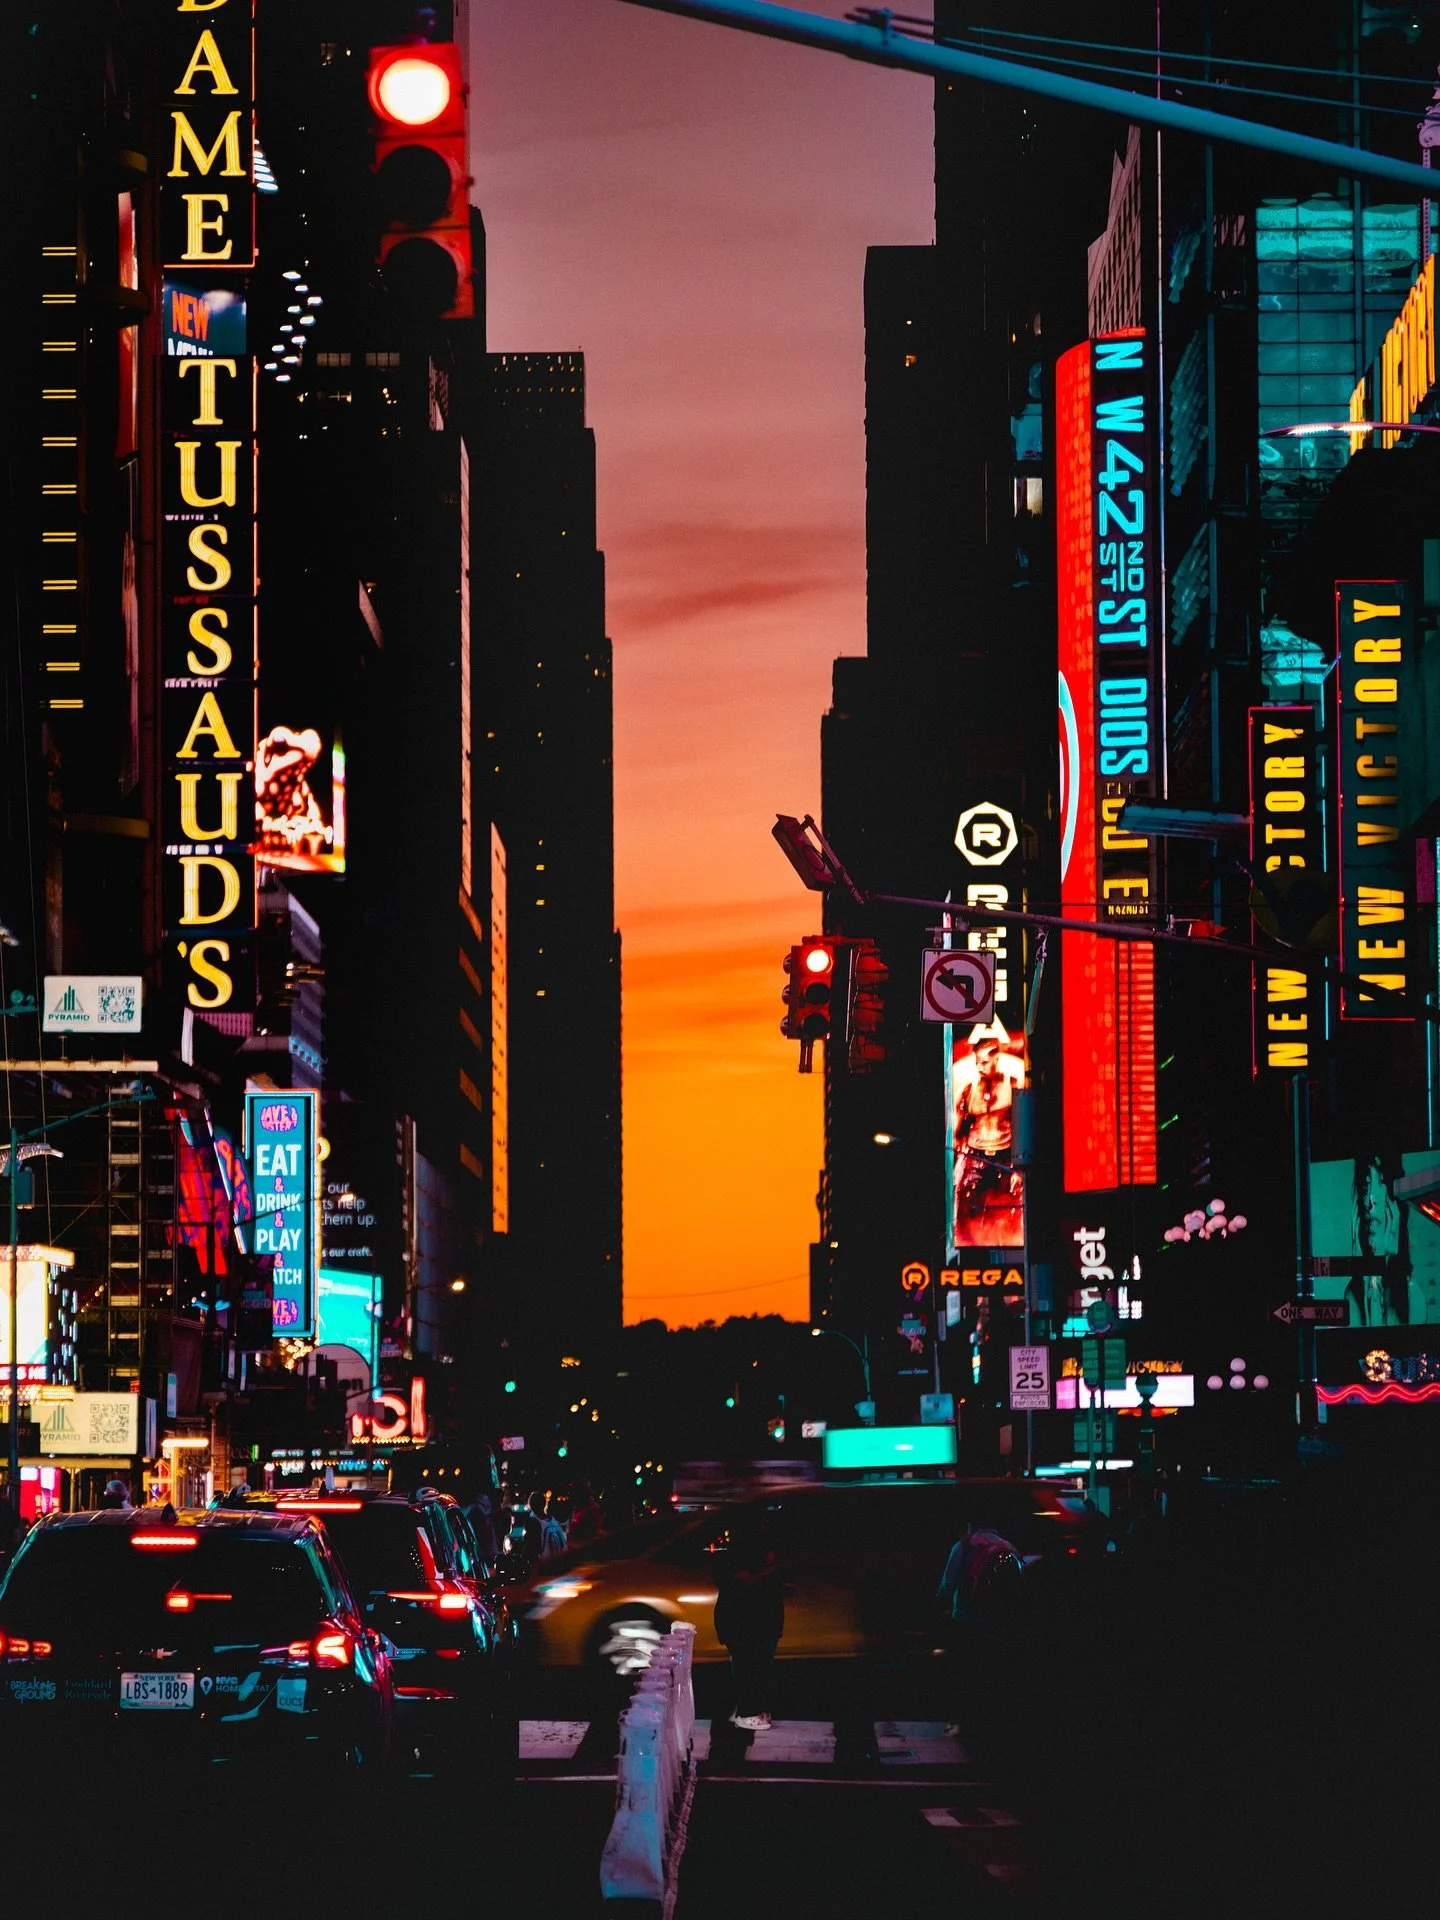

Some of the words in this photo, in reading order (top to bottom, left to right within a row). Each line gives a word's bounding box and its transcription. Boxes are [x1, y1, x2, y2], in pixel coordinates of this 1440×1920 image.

[172, 290, 210, 342] NEW
[174, 358, 244, 1010] TUSSAUD'S
[1352, 597, 1402, 847] VICTORY
[1263, 722, 1306, 873] CTORY
[972, 823, 1001, 847] R
[1355, 885, 1406, 1003] NEW
[49, 1013, 90, 1021] PYRAMID
[1267, 966, 1308, 1068] NEW
[256, 1144, 303, 1176] EAT
[274, 1177, 284, 1192] &
[327, 1184, 350, 1195] our
[256, 1193, 303, 1212] DRINK
[274, 1212, 284, 1228] &
[256, 1228, 303, 1252] PLAY
[273, 1252, 284, 1267] &
[1281, 1308, 1304, 1319] ONE
[1315, 1307, 1339, 1318] WAY
[1016, 1372, 1044, 1389] 25
[40, 1434, 81, 1442] YRAMID
[10, 1676, 56, 1691] BREAKING
[14, 1690, 56, 1704] GROUND
[280, 1698, 303, 1707] CUCS
